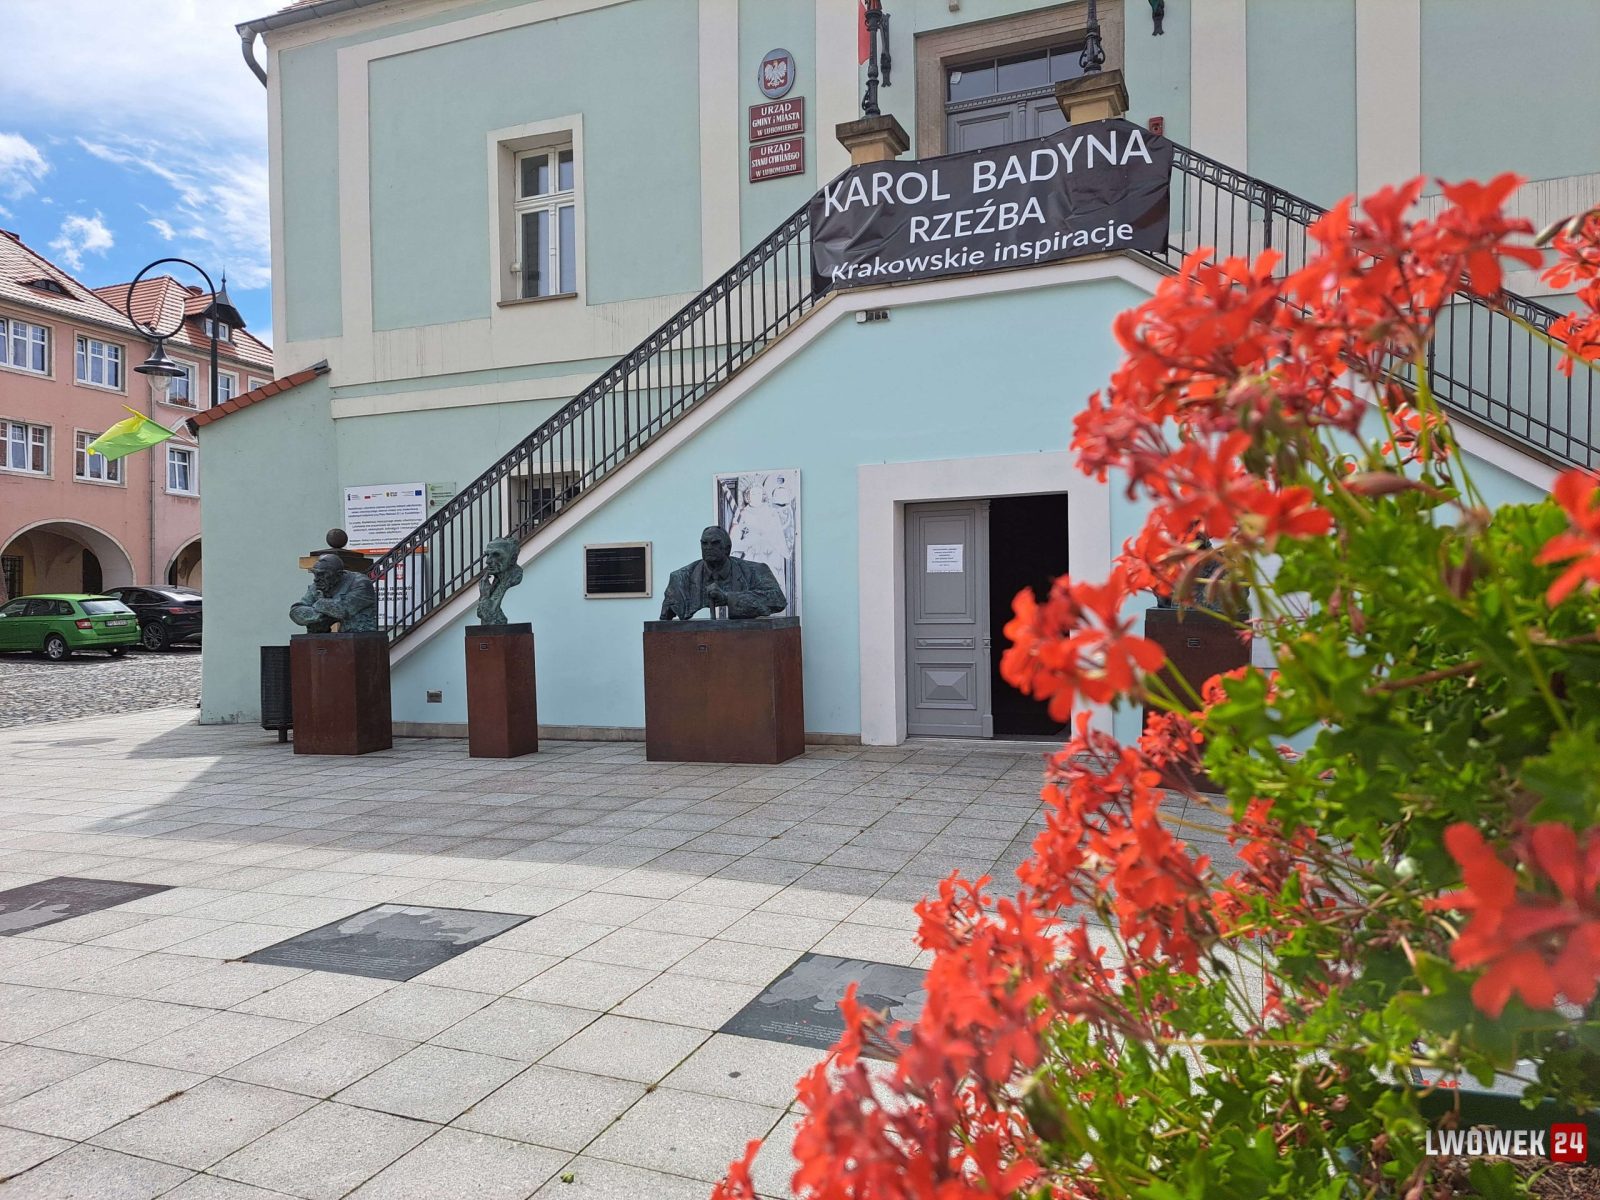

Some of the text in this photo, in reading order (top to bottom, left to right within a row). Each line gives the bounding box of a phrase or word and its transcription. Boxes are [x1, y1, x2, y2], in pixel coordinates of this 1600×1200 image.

[761, 103, 791, 115] URZĄD
[752, 117, 771, 127] GMINY
[776, 112, 800, 122] MIASTA
[764, 123, 798, 135] LUBOMIERZU
[761, 143, 791, 155] URZĄD
[752, 152, 800, 167] STANU CYWILNEGO
[763, 164, 796, 175] LUBOMIERZU
[823, 129, 1153, 217] KAROL BADYNA
[909, 196, 1046, 243] RZEŹBA
[831, 219, 1134, 283] Krakowskie inspiracje
